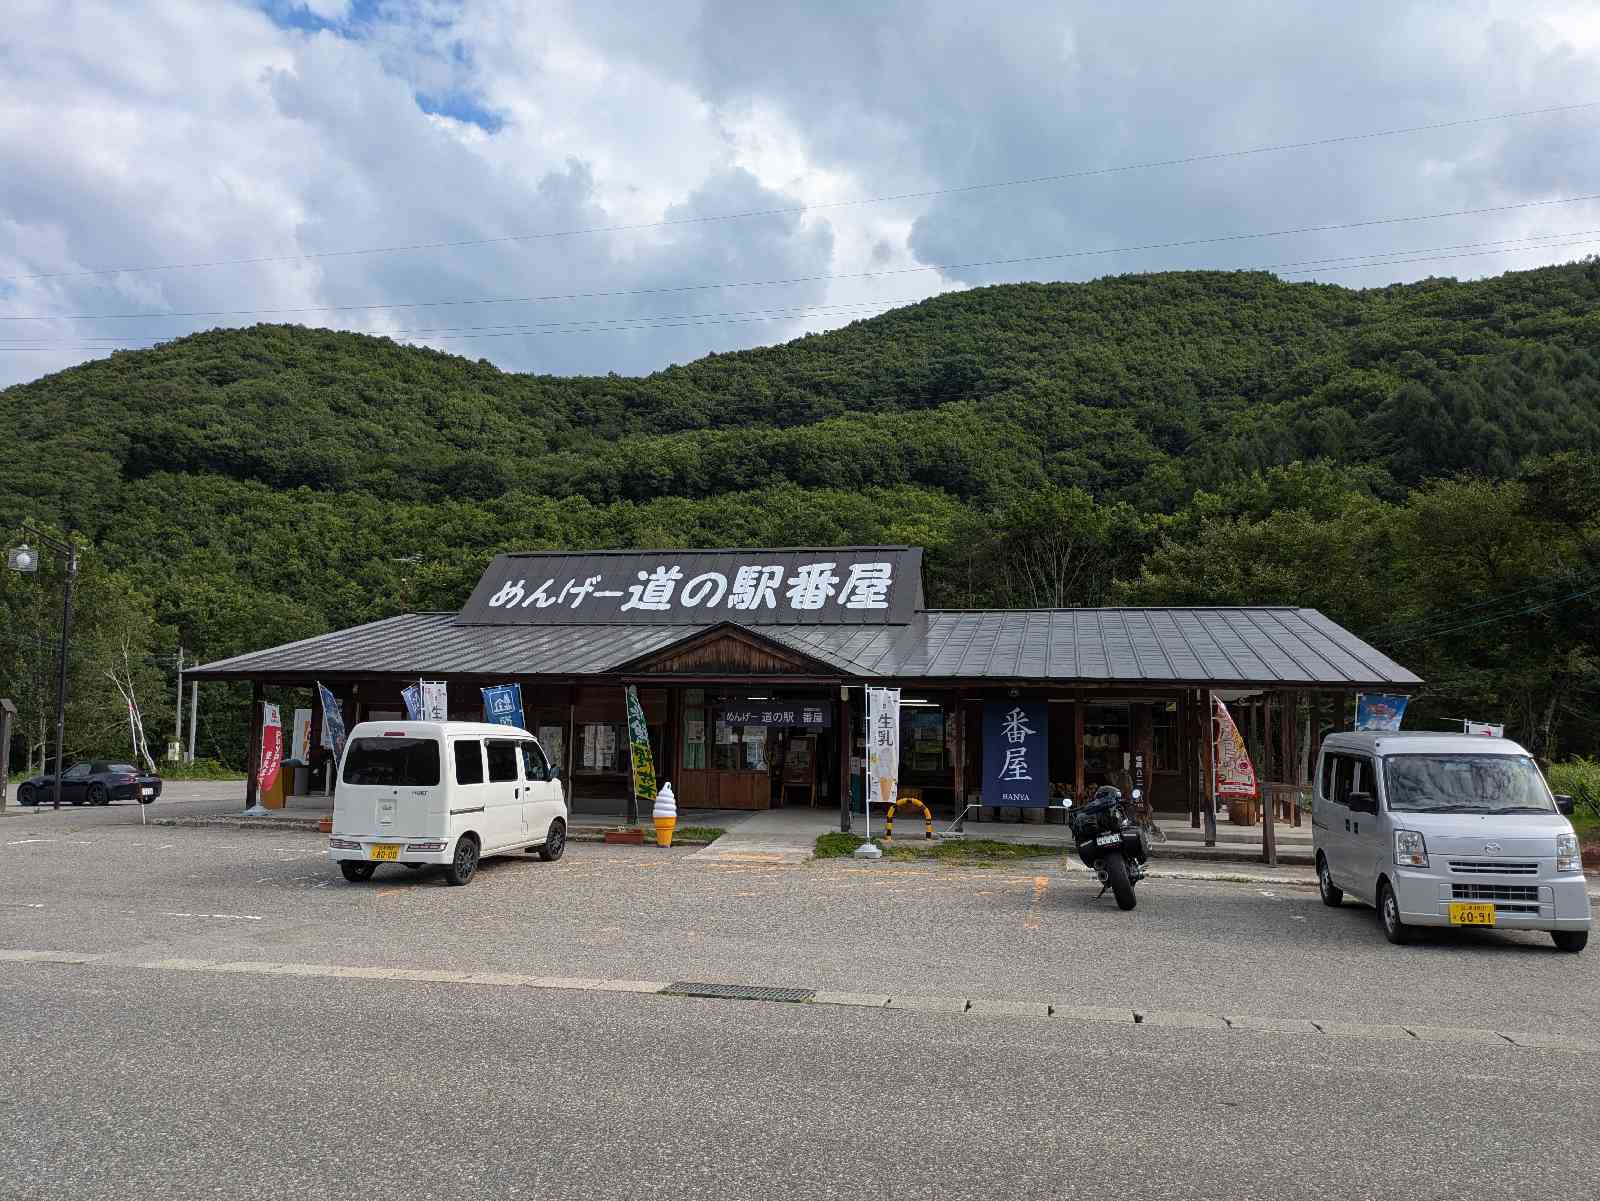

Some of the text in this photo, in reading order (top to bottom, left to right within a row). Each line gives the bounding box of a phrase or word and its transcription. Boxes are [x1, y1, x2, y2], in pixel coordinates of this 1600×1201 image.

[877, 712, 894, 747] 生乳
[998, 707, 1037, 781] 番屋
[1001, 792, 1030, 801] HANYA
[1459, 911, 1492, 923] 60-91
